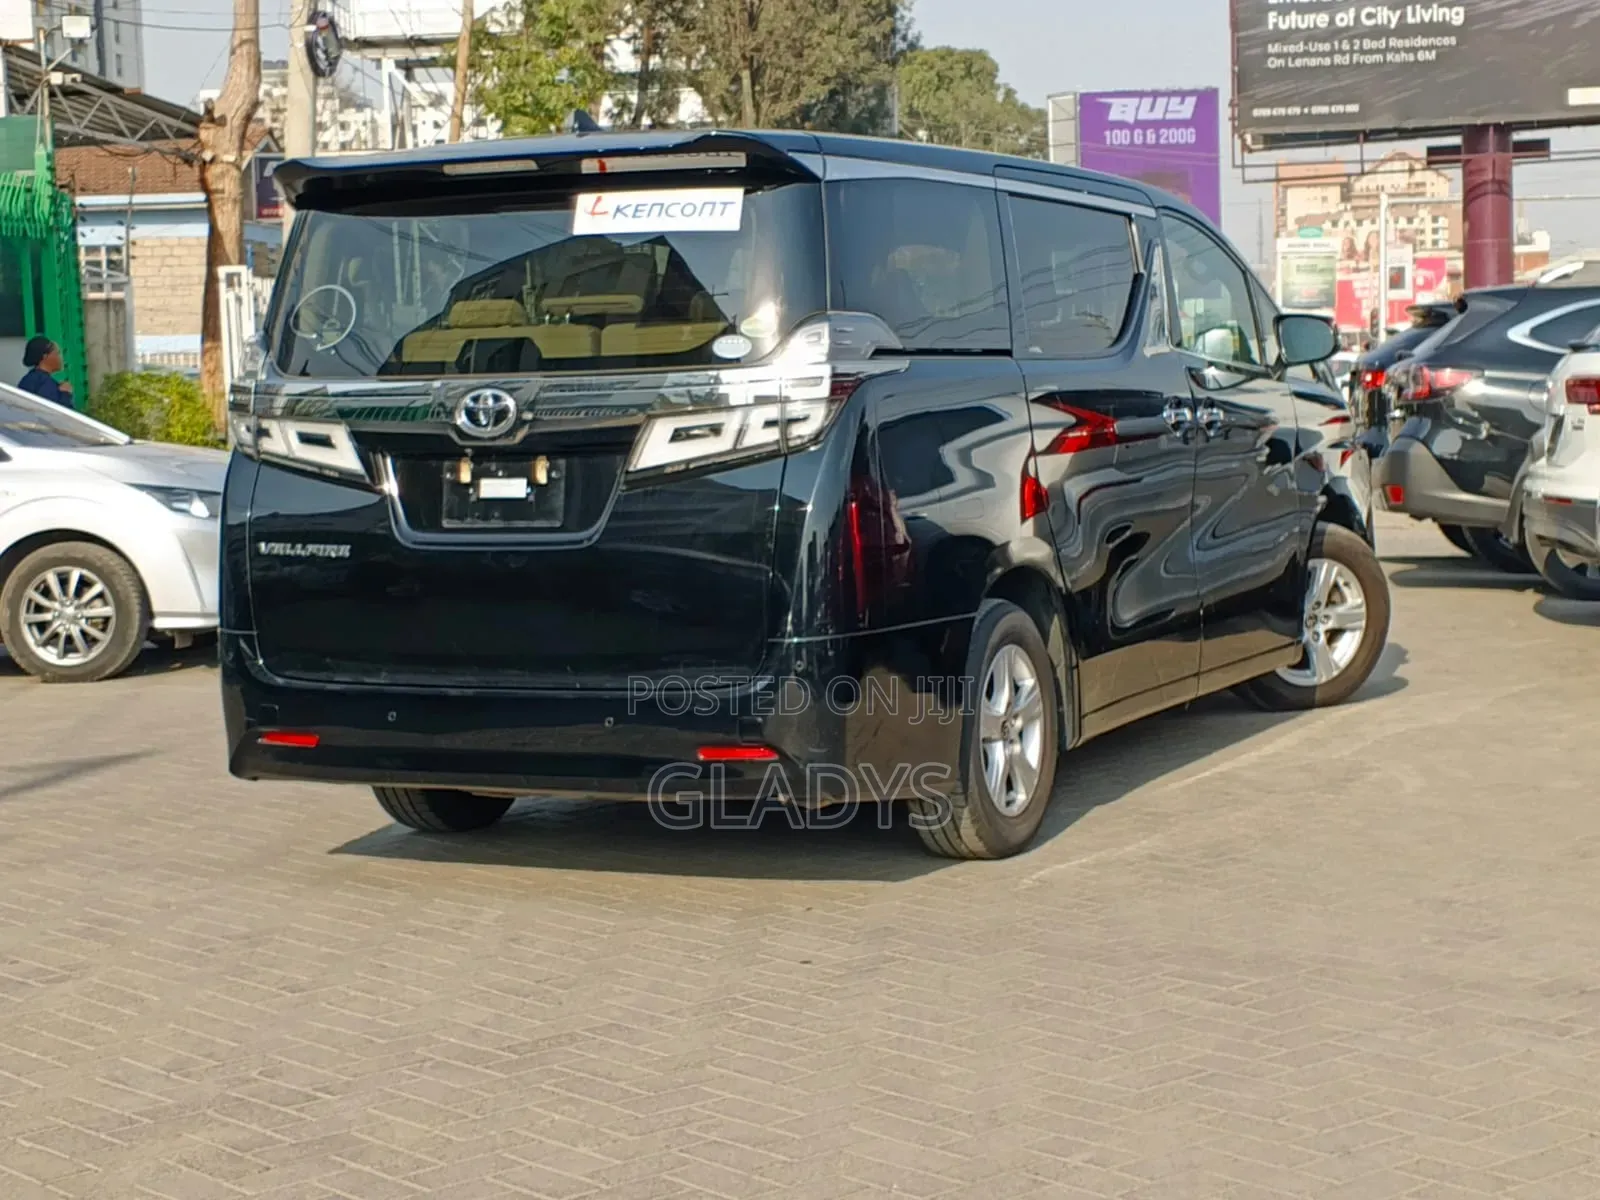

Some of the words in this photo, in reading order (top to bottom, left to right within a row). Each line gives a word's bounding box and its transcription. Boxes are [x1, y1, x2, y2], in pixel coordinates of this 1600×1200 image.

[1267, 10, 1330, 31] Future
[1335, 7, 1356, 28] of
[1361, 6, 1401, 30] City
[1406, 3, 1465, 26] Living
[1267, 41, 1331, 54] Mixed-Use
[1334, 40, 1339, 51] 1
[1341, 39, 1350, 51] &
[1353, 38, 1360, 50] 2
[1362, 38, 1386, 49] Bed
[1389, 35, 1457, 48] Residences
[1267, 56, 1285, 69] On
[1288, 56, 1331, 68] Lenana
[1333, 53, 1350, 66] Rd
[1352, 53, 1383, 64] From
[1096, 96, 1197, 124] BUY
[1104, 129, 1130, 145] 100
